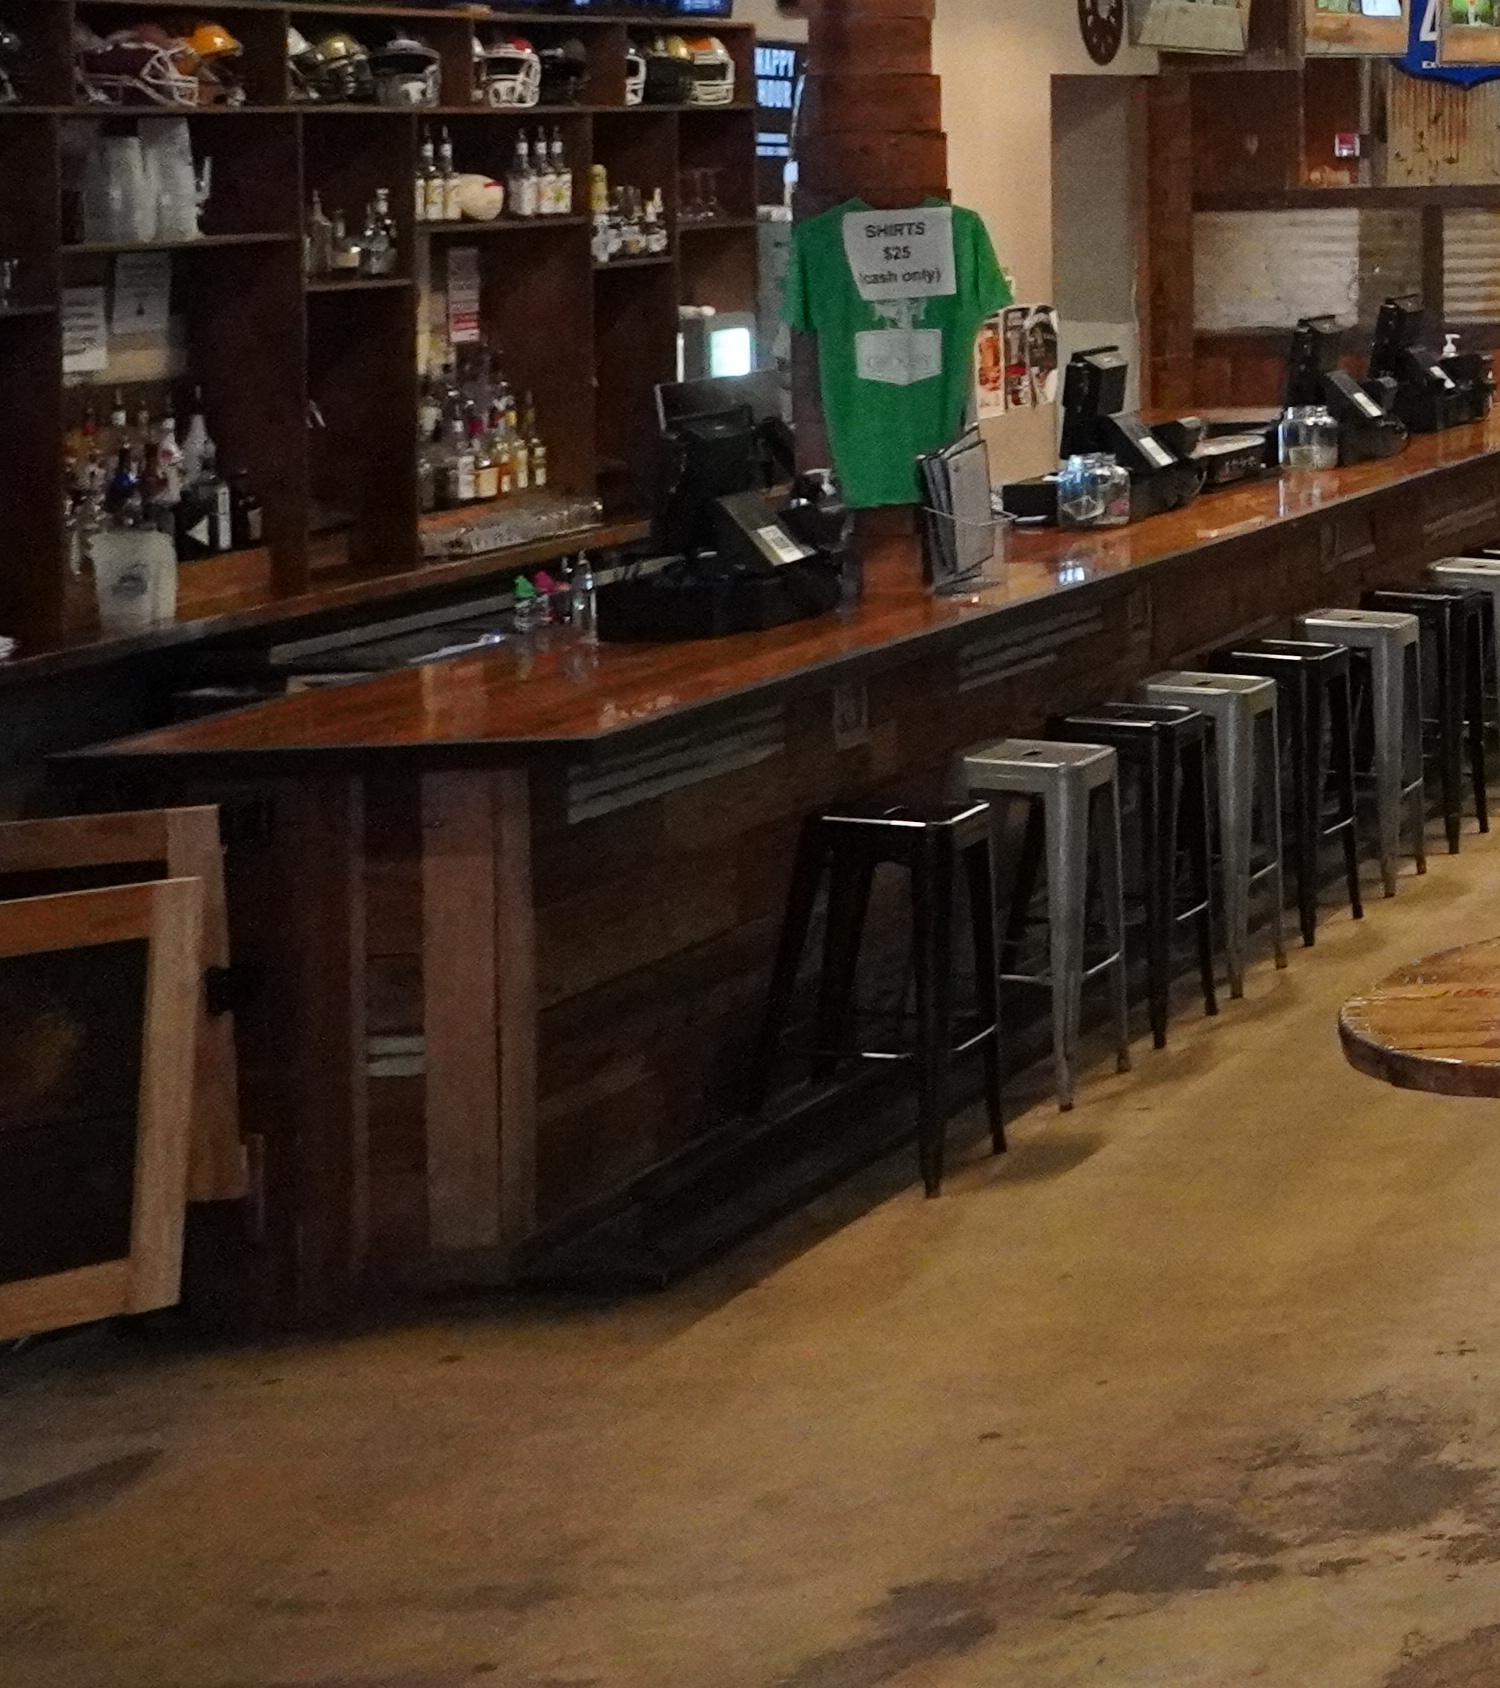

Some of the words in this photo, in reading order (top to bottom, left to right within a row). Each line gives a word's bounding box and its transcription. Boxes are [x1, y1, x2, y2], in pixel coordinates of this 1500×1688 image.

[865, 221, 926, 239] SHIRTS
[882, 245, 911, 261] $25
[902, 267, 942, 284] only)
